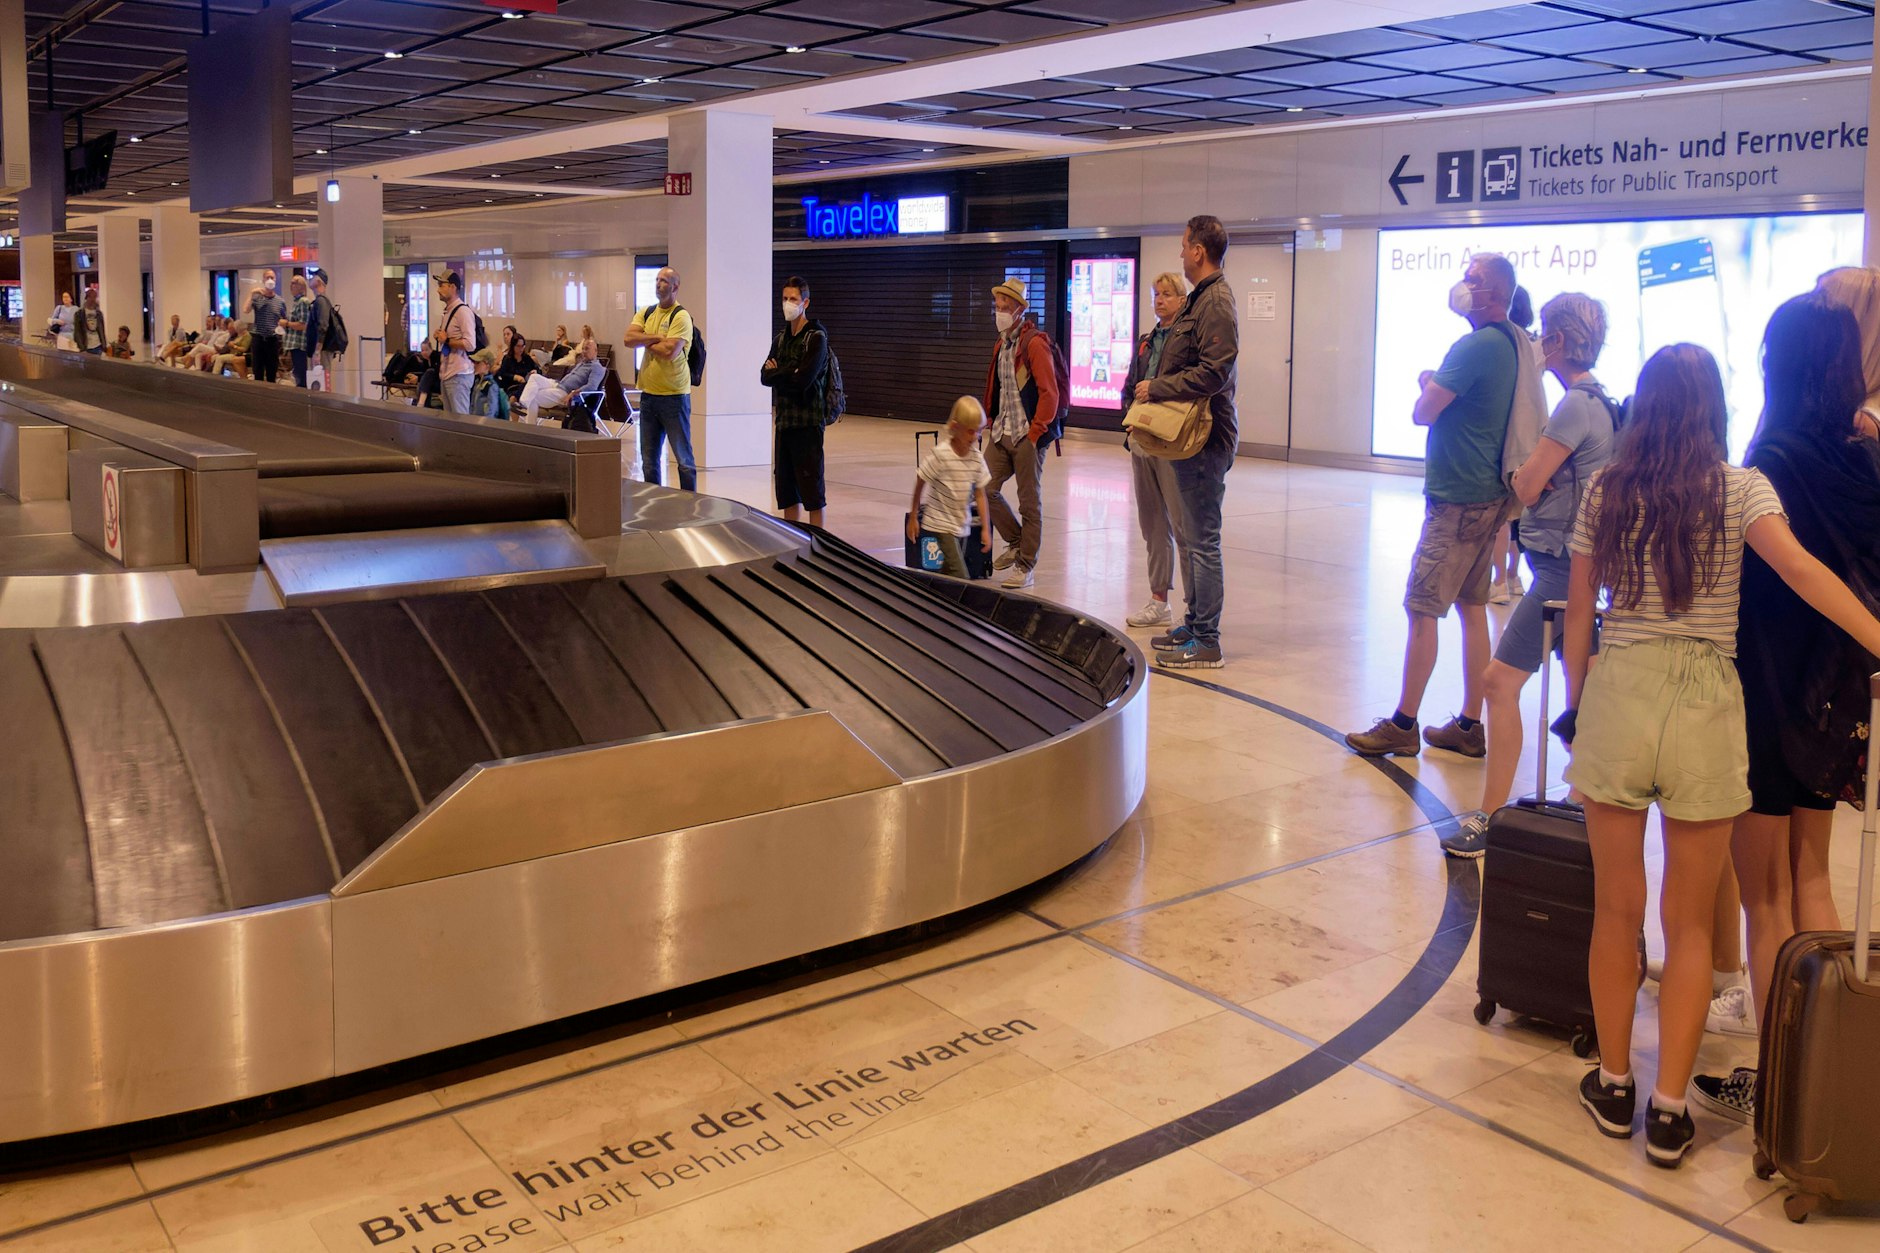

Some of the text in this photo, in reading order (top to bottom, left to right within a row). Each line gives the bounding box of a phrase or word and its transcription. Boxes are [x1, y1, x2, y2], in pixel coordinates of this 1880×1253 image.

[1529, 144, 1604, 168] Tickets
[1613, 137, 1669, 164] Nah-
[1679, 131, 1726, 158] und
[1528, 165, 1779, 197] Tickets for Public Transport
[802, 192, 898, 237] Travelex
[900, 199, 945, 215] worldwide
[900, 216, 928, 231] money
[1391, 244, 1598, 275] Berlin Aort App
[358, 1019, 1038, 1247] Bitte hinter der Linie warten
[543, 1180, 642, 1223] wait
[640, 1131, 784, 1190] behind
[785, 1111, 855, 1140] the
[849, 1086, 925, 1117] line
